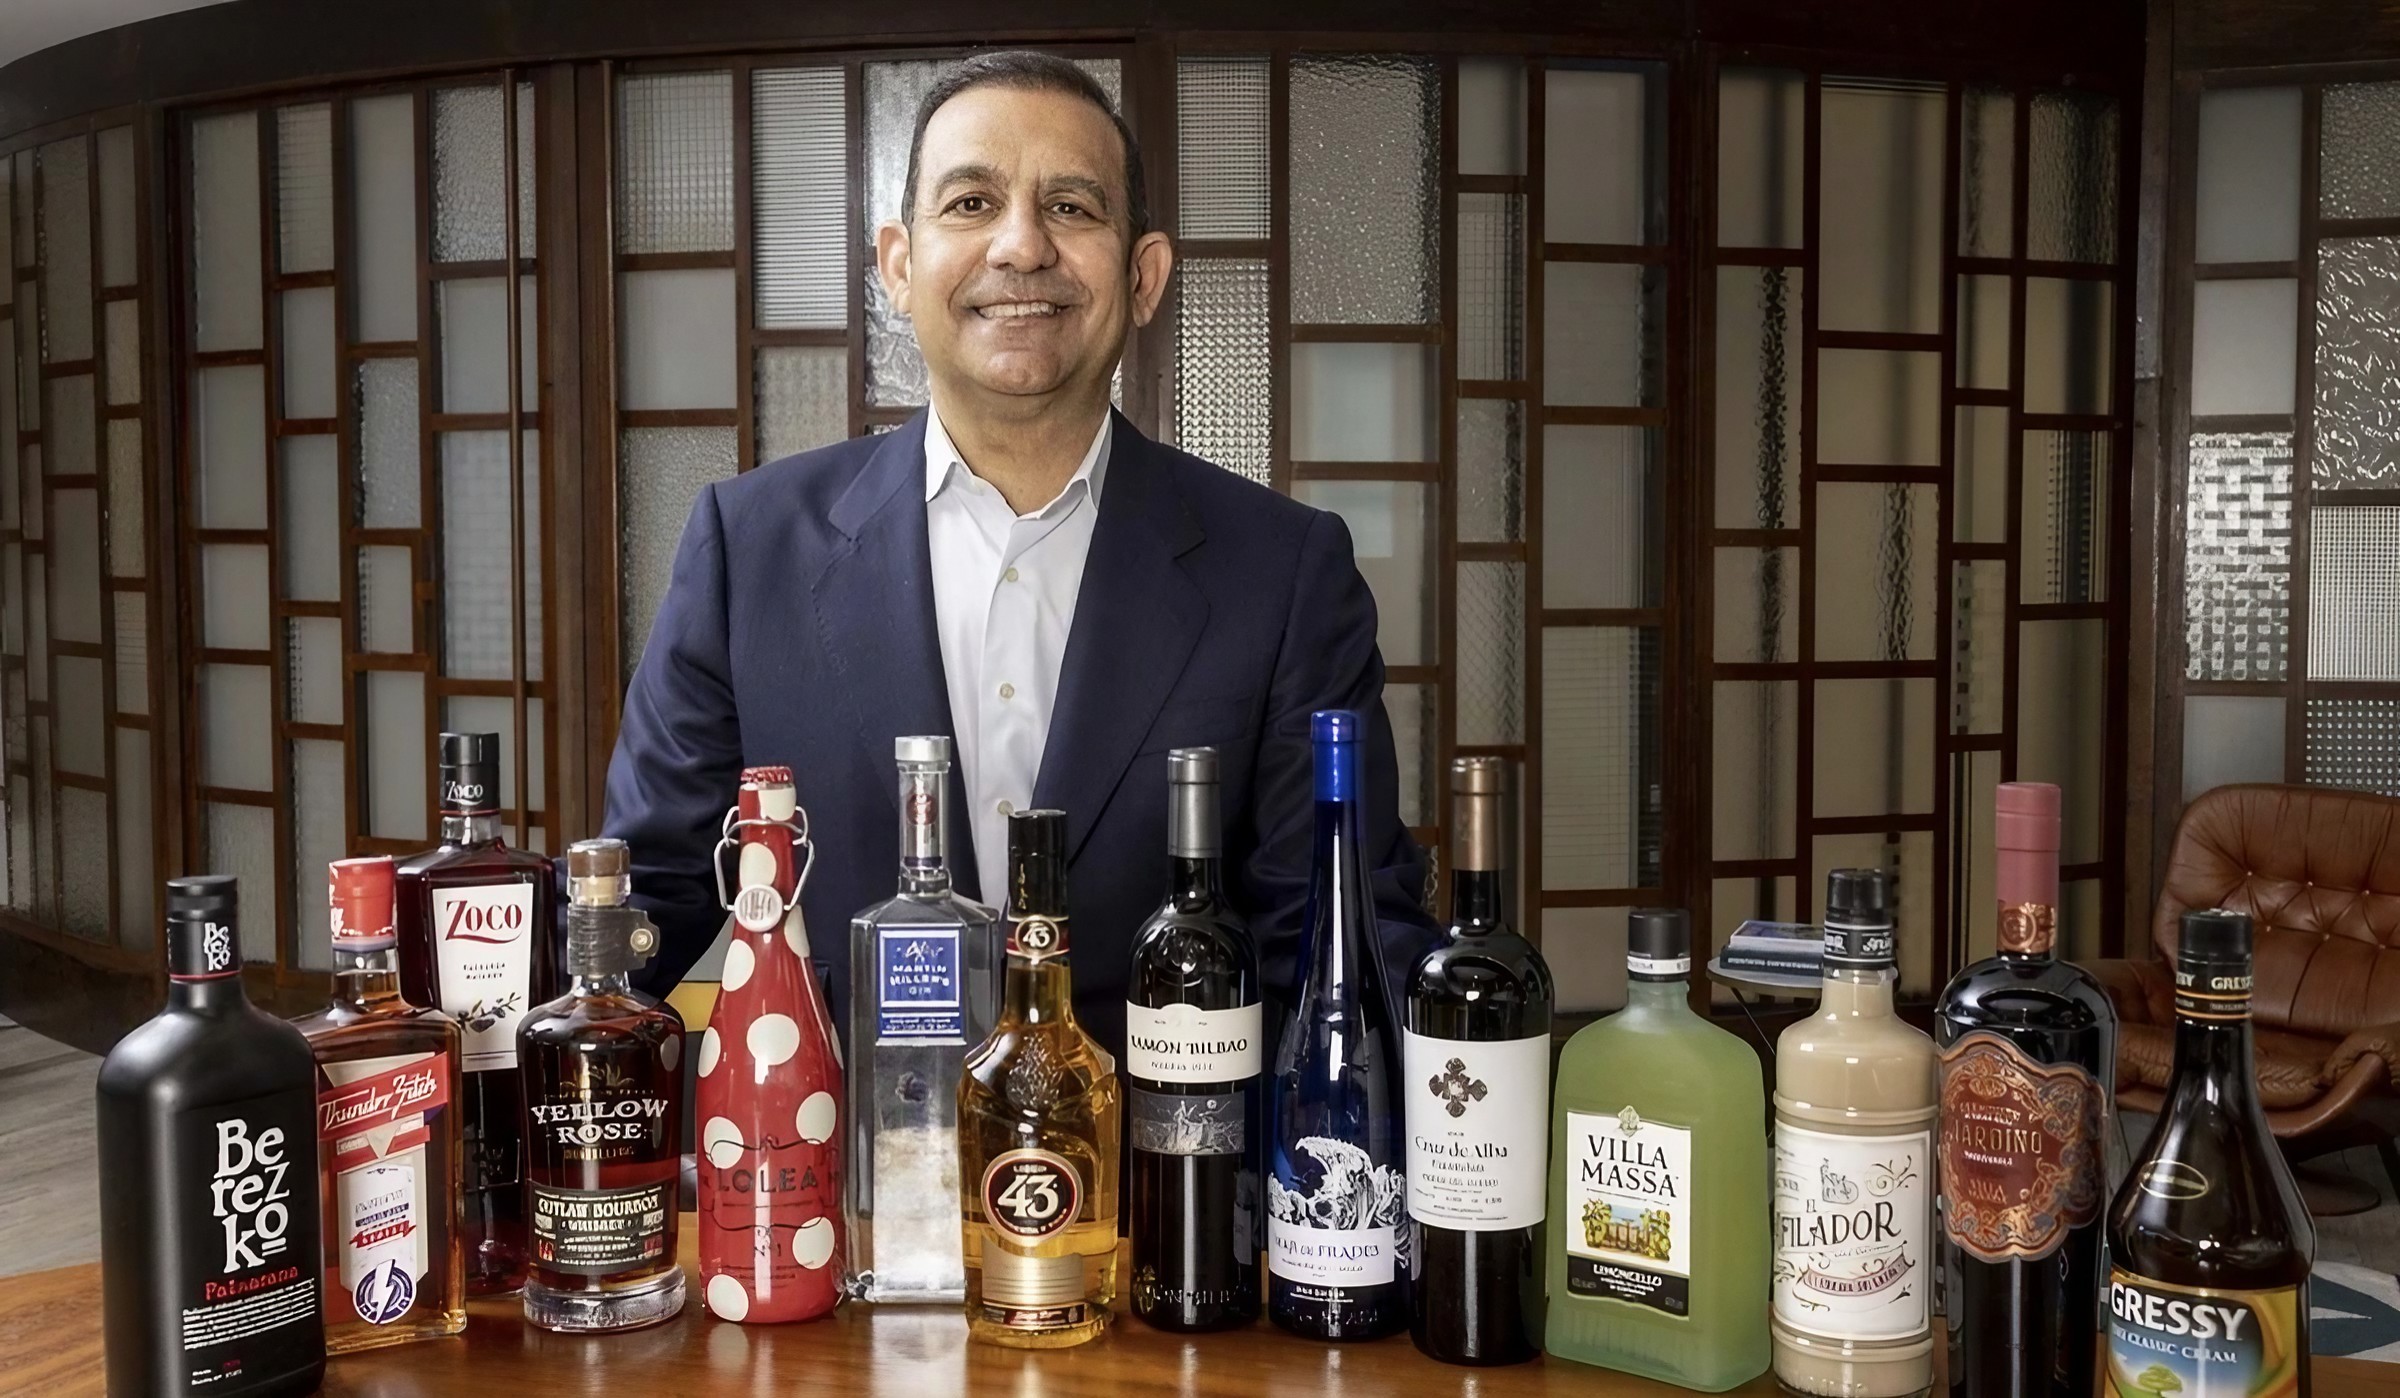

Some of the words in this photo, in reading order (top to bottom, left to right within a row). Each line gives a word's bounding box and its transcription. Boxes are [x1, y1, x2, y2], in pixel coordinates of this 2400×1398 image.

[530, 1098, 669, 1125] YELLOW
[556, 1122, 642, 1145] ROSE
[1587, 1134, 1668, 1170] VILLA
[997, 1174, 1060, 1219] 43
[1581, 1158, 1677, 1199] MASSA
[2111, 1281, 2248, 1342] GRESSY
